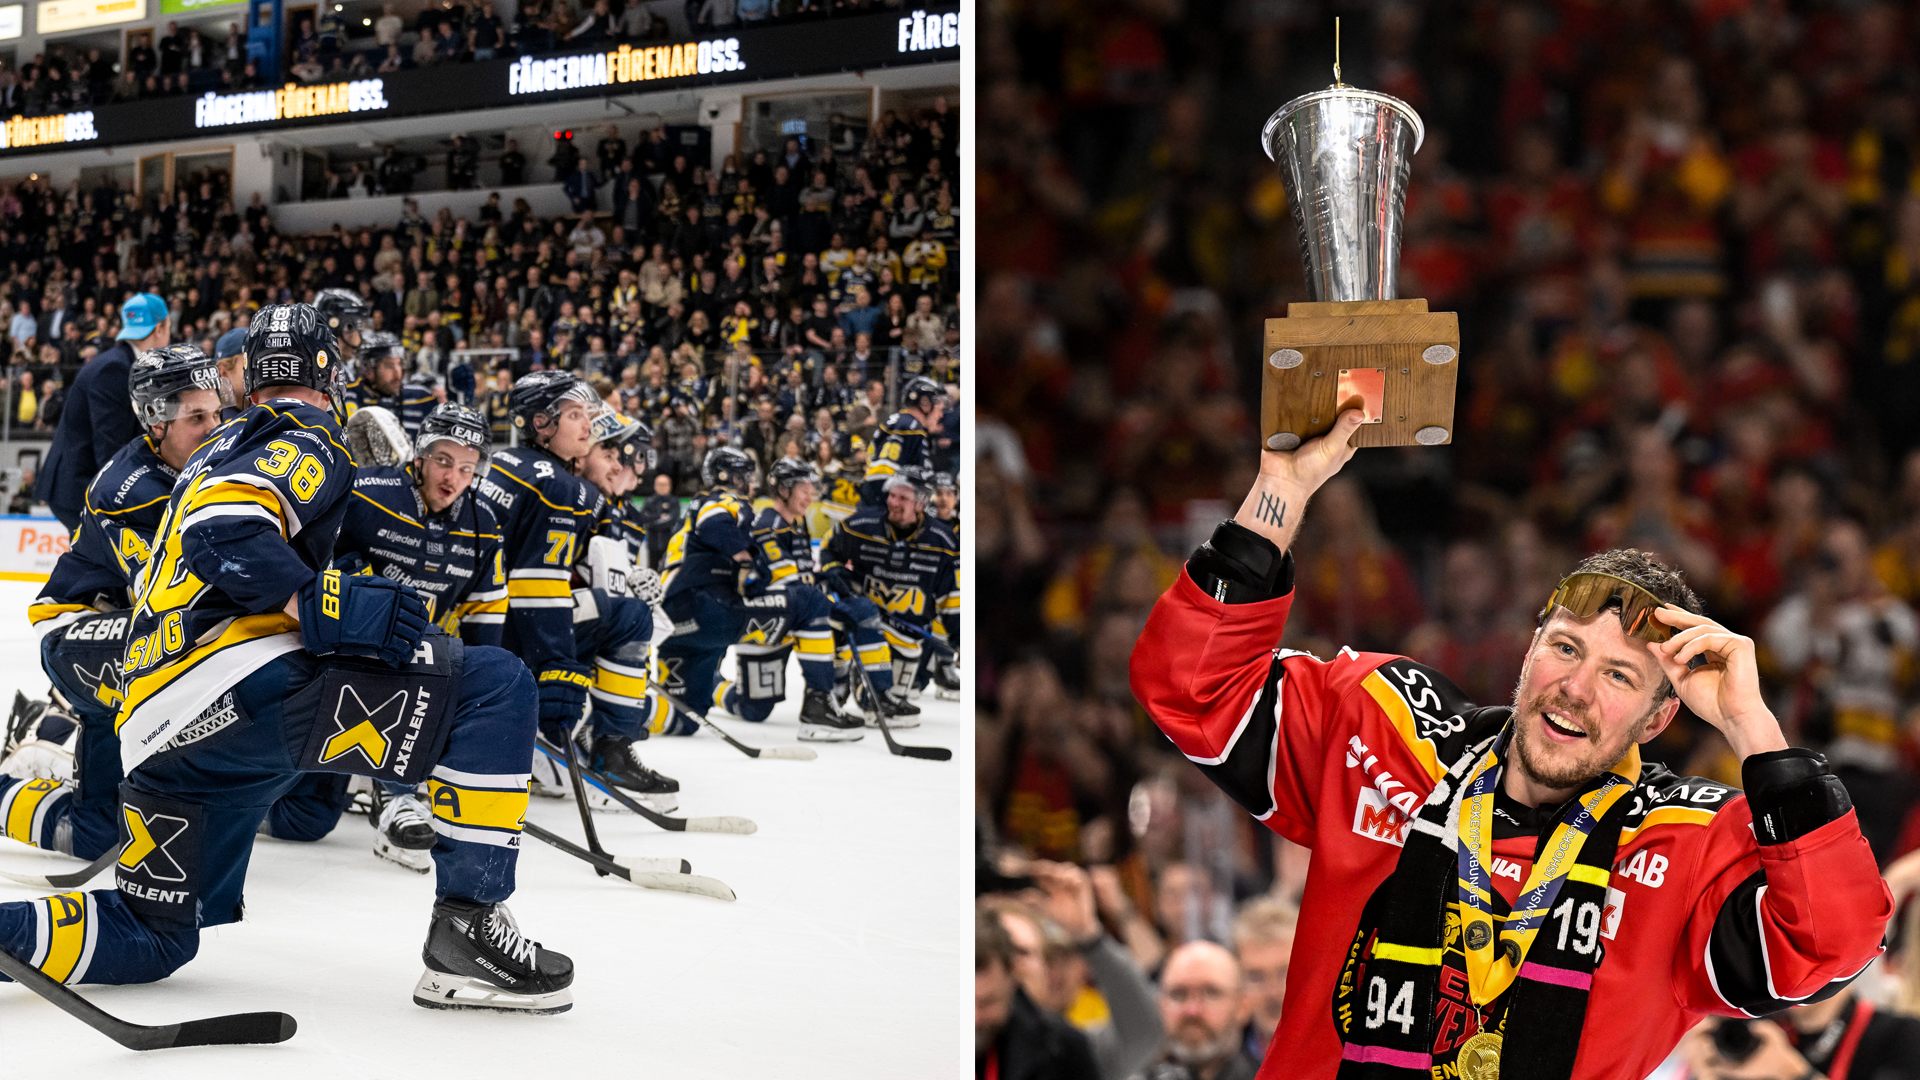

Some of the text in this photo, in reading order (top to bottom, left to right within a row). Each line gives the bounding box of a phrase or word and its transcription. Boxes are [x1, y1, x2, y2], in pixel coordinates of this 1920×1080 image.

[898, 9, 960, 53] FÄRG
[271, 320, 288, 332] 38
[194, 367, 218, 382] EAB
[262, 360, 299, 377] HSE
[454, 426, 481, 444] EAB
[254, 439, 326, 504] 38
[119, 527, 152, 566] 4
[543, 530, 577, 567] 71
[763, 540, 781, 561] 5
[609, 572, 626, 593] EAB
[393, 686, 431, 777] AXELENT
[1469, 775, 1484, 910] ISHOCKEYFÖRBUNDET
[1515, 775, 1621, 934] SVENSKA ISHOCKEYFÖRBUNDET
[1618, 848, 1669, 888] AB
[115, 875, 190, 904] AXELENT
[1553, 897, 1600, 955] 19
[1366, 975, 1415, 1035] 94
